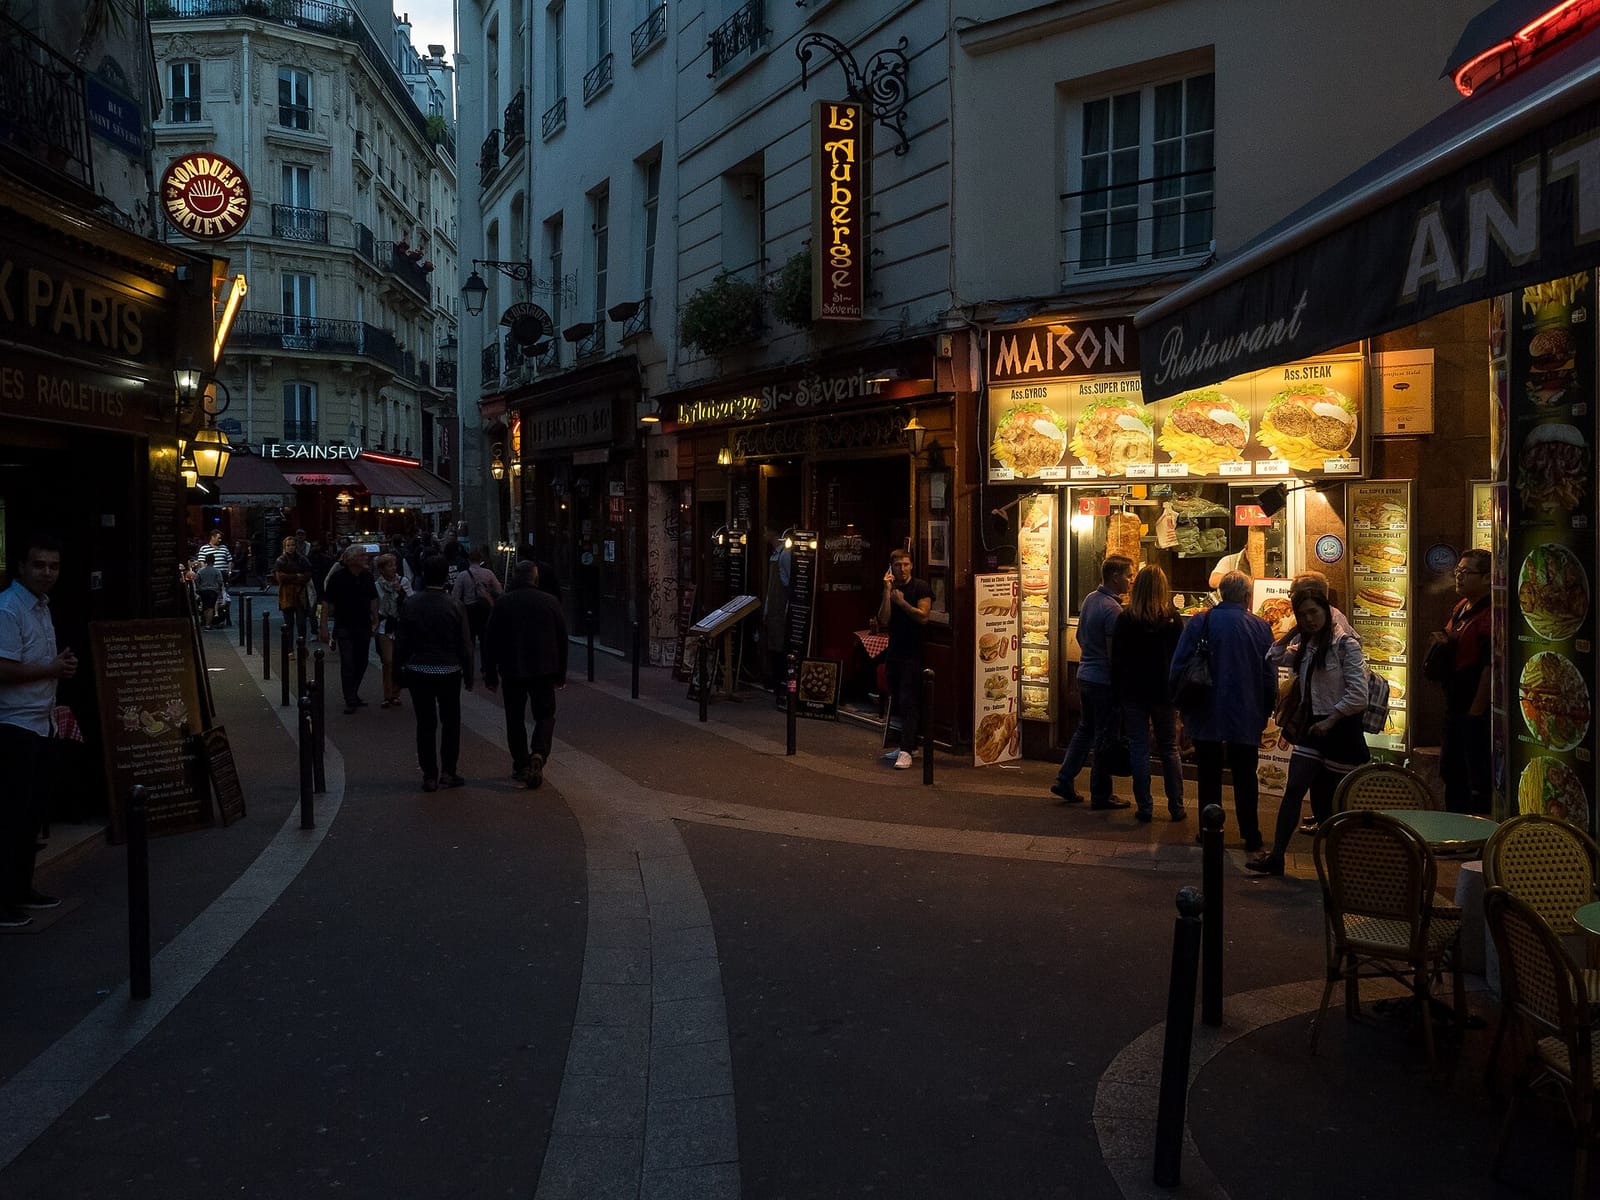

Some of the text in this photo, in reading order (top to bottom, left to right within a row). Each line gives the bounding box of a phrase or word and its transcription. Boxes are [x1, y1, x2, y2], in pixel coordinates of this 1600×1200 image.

[167, 157, 242, 190] FONDUES
[167, 196, 247, 235] RACLETTES
[27, 269, 144, 355] PARIS
[995, 324, 1125, 376] MAISON
[1154, 289, 1308, 385] Restaurant
[1079, 380, 1142, 396] Ass.SUPER GYRO
[1284, 365, 1332, 381] Ass.STEAK
[37, 374, 124, 417] RACLETTES
[1010, 387, 1048, 400] Ass.GYROS
